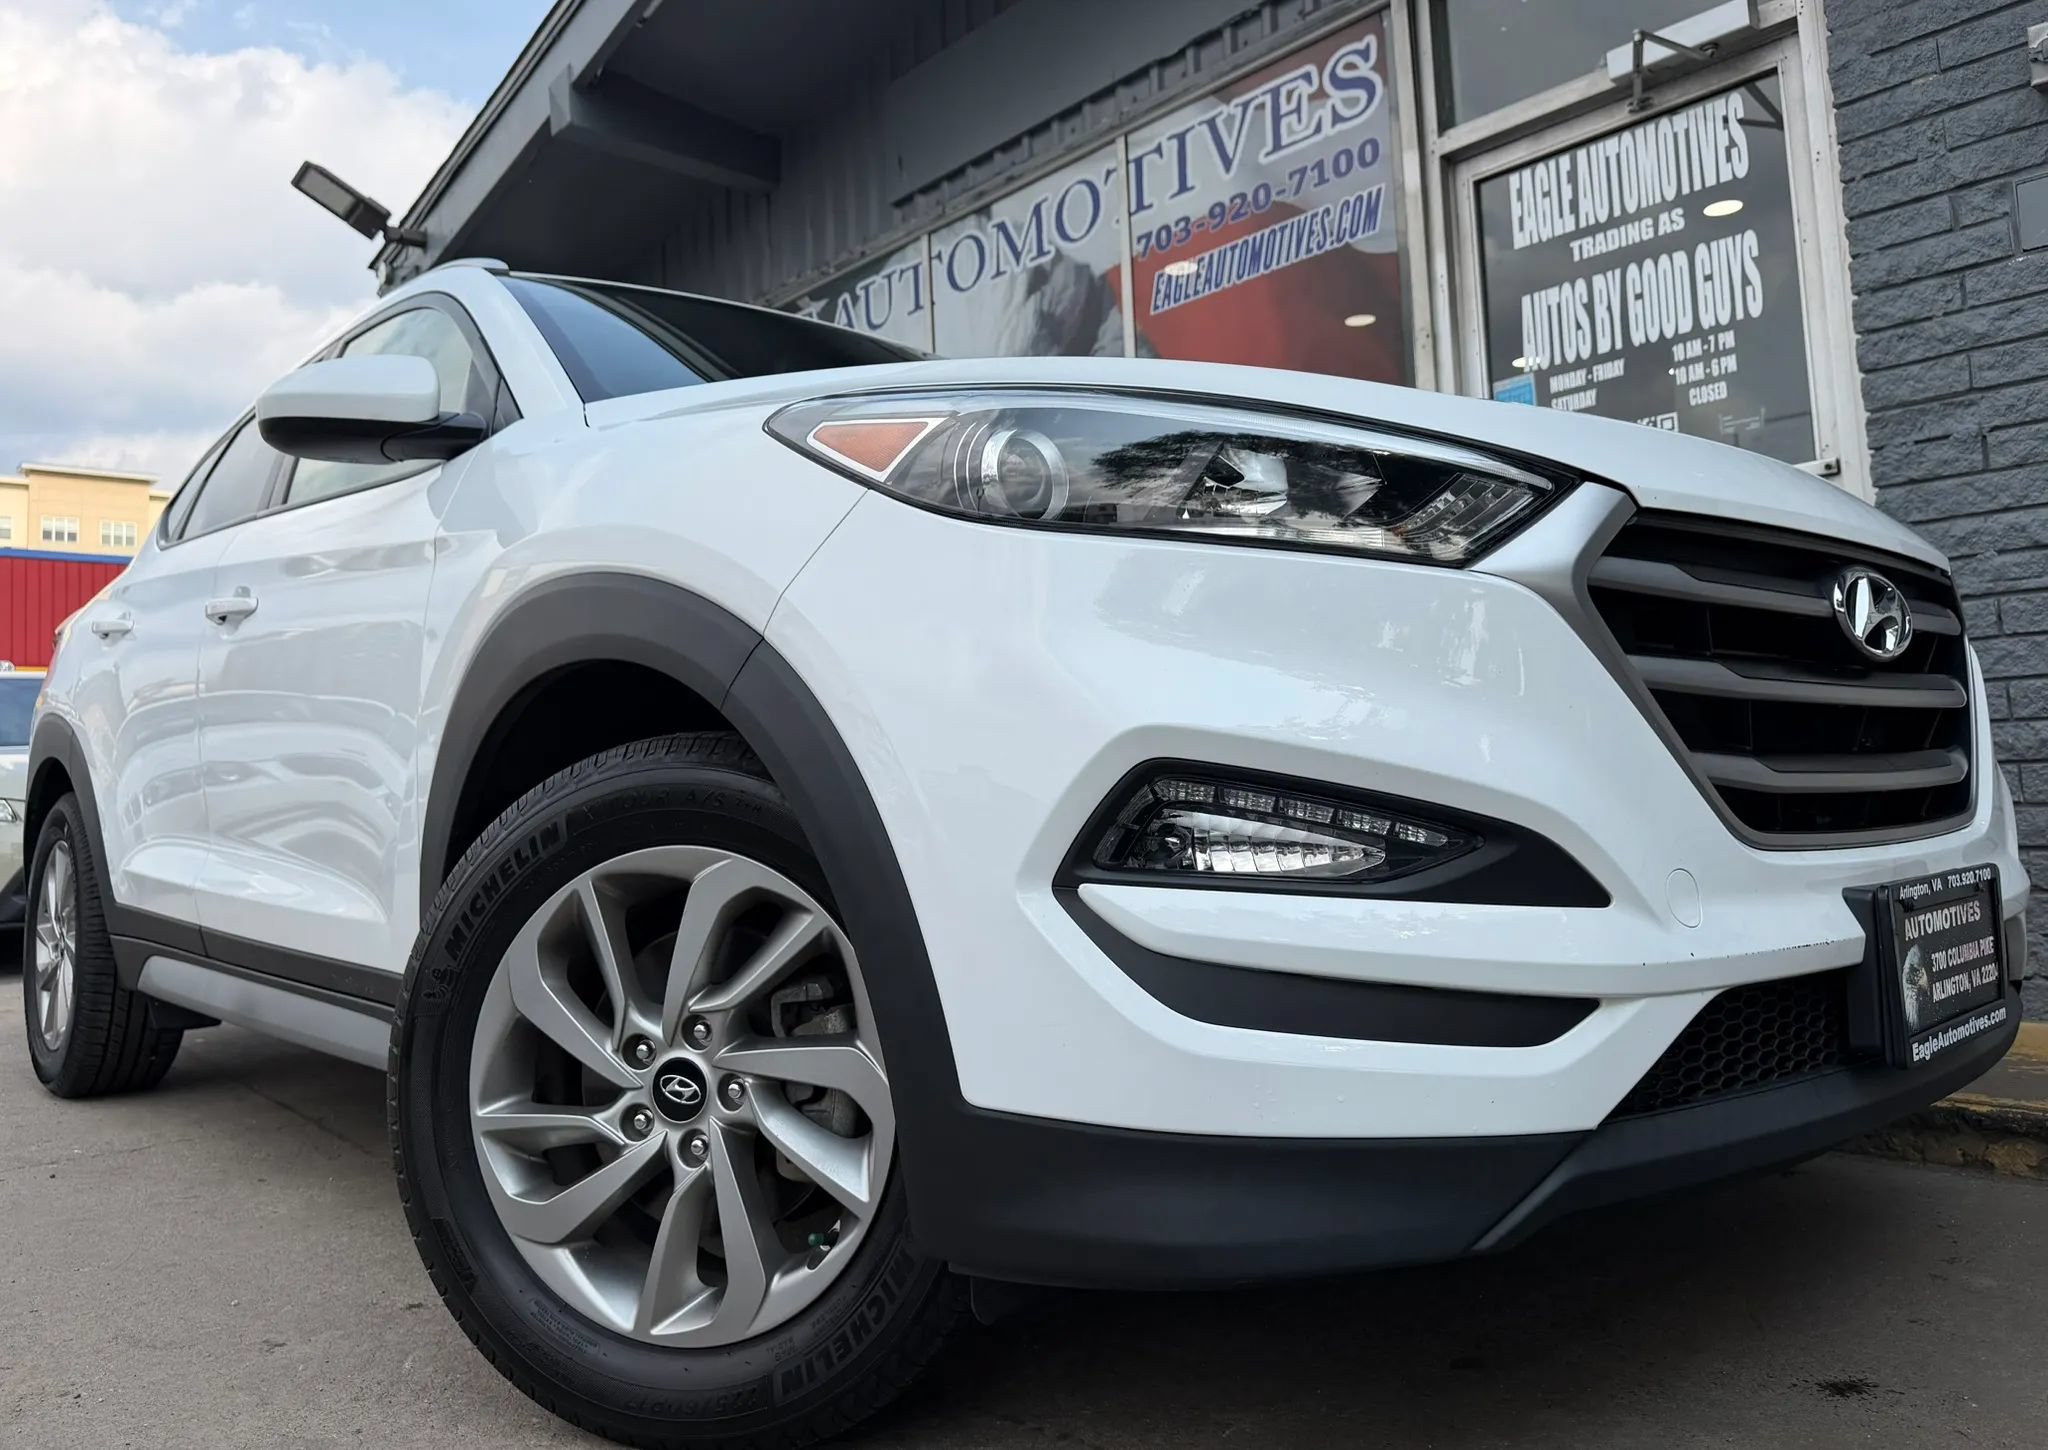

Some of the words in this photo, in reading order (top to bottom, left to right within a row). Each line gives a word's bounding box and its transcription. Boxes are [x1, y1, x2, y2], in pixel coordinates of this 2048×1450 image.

[835, 35, 1381, 331] AUTOMOTIVES
[1508, 154, 1575, 250] EAGLE
[1576, 92, 1749, 229] AUTOMOTIVES
[1136, 137, 1381, 259] 703-920-7100
[1152, 186, 1383, 313] EAGLEAUTOMOTIVES.COM
[1569, 217, 1654, 261] TRADING
[1657, 207, 1685, 235] AS
[1521, 277, 1592, 373] AUTOS
[1592, 267, 1623, 355] BY
[1626, 250, 1693, 347] GOOD
[1694, 229, 1763, 330] GUYS
[1672, 344, 1686, 363] 10
[1685, 338, 1703, 360] AM
[1708, 334, 1715, 353] 7
[1718, 330, 1736, 351] PM
[1675, 367, 1687, 386] 10
[1687, 361, 1705, 383] AM
[1711, 358, 1719, 378] 6
[1720, 354, 1738, 375] PM
[1549, 367, 1587, 394] MONDAY
[1592, 358, 1625, 382] FRIDAY
[1689, 381, 1728, 406] CLOSED
[1551, 388, 1597, 413] SATURDAY
[443, 819, 563, 963] MICHELIN
[1899, 882, 1931, 900] Arlington,
[1931, 877, 1943, 892] VA
[1947, 867, 1991, 889] 703.920.7100
[1904, 900, 1981, 941] AUTOMOTIVES
[1931, 950, 1947, 972] 3700
[1948, 940, 1980, 968] COLUMBIA
[1979, 935, 1995, 957] PIKE
[1933, 971, 1972, 1003] ARLINGTON,
[1971, 967, 1982, 988] VA
[1911, 1006, 2008, 1062] EagleAutomotives.com
[780, 1248, 916, 1397] MICHELIN
